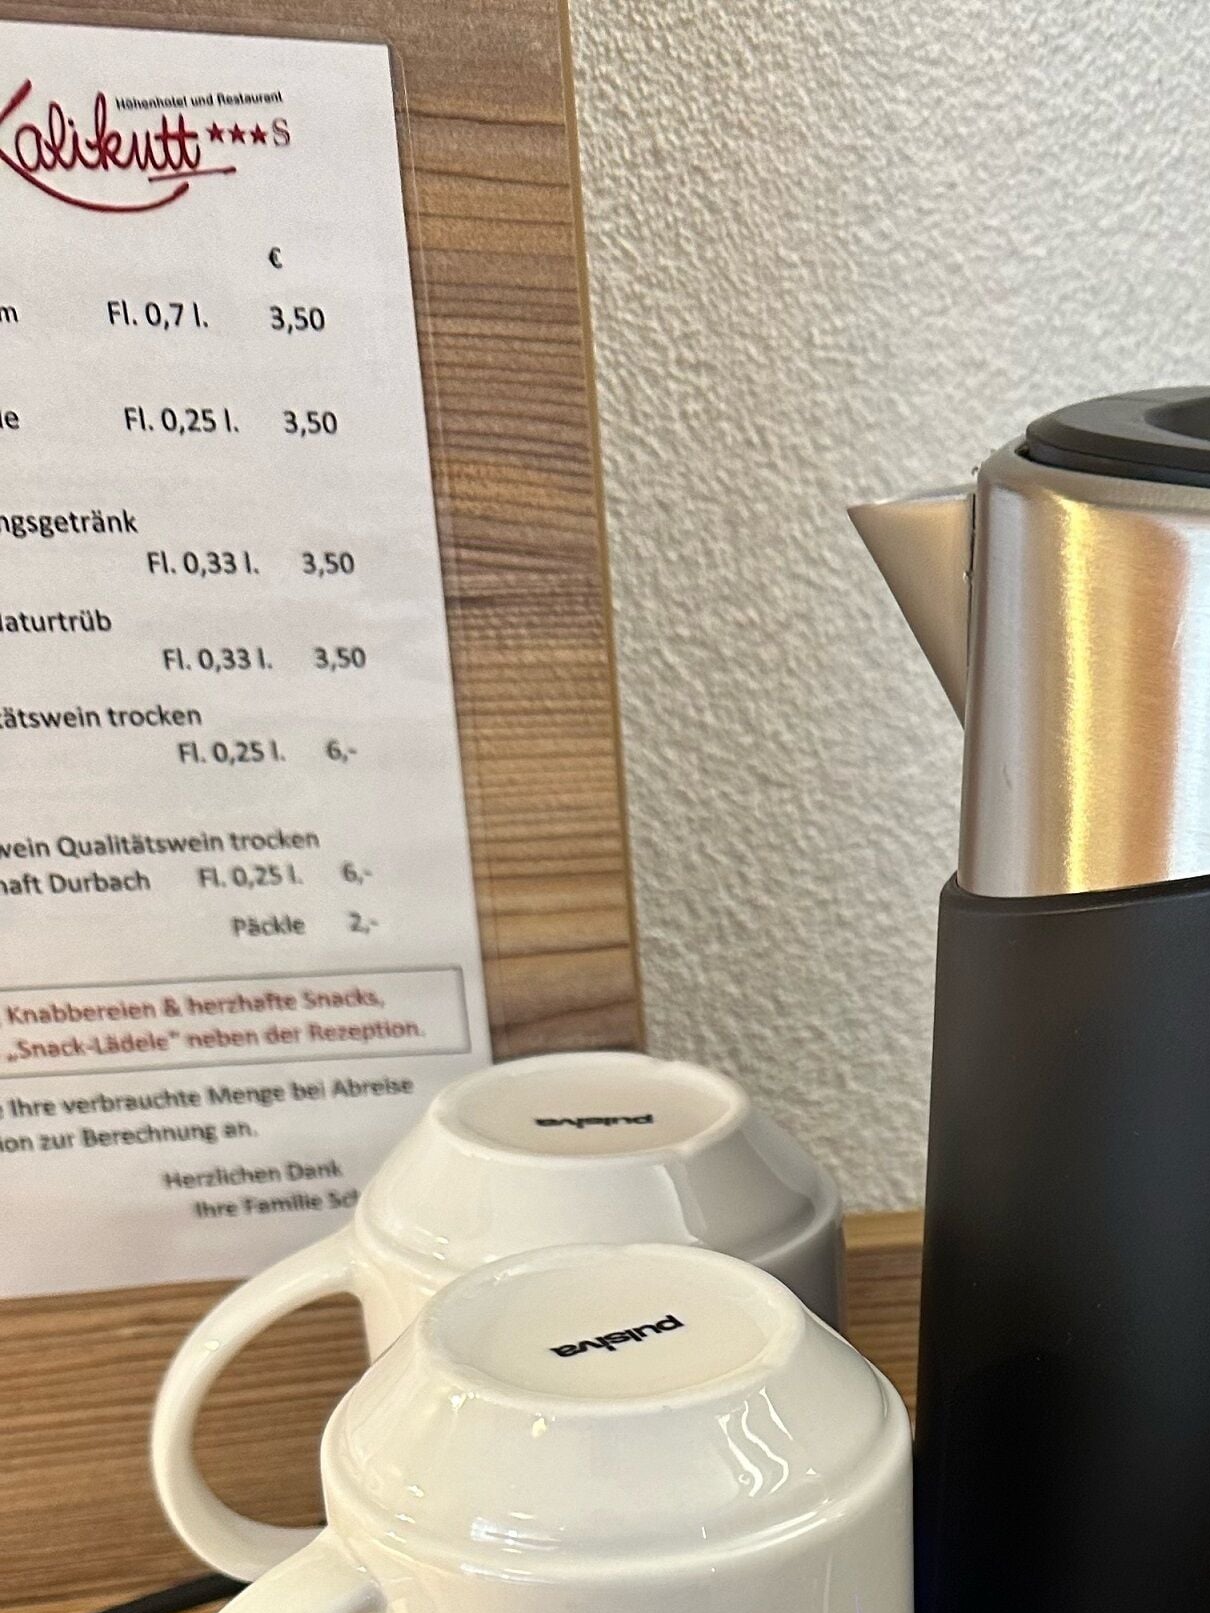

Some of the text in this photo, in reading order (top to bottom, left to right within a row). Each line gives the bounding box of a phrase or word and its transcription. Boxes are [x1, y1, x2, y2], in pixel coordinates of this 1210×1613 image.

[191, 95, 214, 107] und
[216, 90, 283, 107] Restaurant
[269, 248, 283, 269] €
[107, 301, 138, 327] Fl.
[145, 302, 183, 331] 0,7
[270, 306, 325, 335] 3,50
[124, 407, 154, 433] Fl.
[161, 408, 217, 436] 0,25
[283, 411, 337, 440] 3,50
[147, 551, 176, 575] Fl.
[183, 552, 237, 580] 0,33
[302, 552, 355, 578] 3,50
[163, 648, 191, 671] Fl.
[199, 649, 250, 674] 0,33
[314, 647, 366, 672] 3,50
[107, 705, 202, 728] trocken
[178, 742, 206, 766] Fl.
[213, 744, 264, 767] 0,25
[326, 739, 357, 764] 6,-
[57, 832, 223, 859] Qualitätswein
[230, 829, 320, 852] trocken
[49, 870, 150, 895] Durbach
[200, 866, 226, 889] Fl.
[233, 865, 282, 889] 0,25
[343, 861, 373, 886] 6,-
[232, 911, 378, 938] Päckle 2,-
[7, 1003, 157, 1025] Knabbereien
[163, 996, 182, 1018] &
[189, 991, 297, 1017] herzhafte
[187, 1029, 258, 1050] neben
[264, 1026, 302, 1045] der
[309, 1020, 424, 1046] Rezeption.
[62, 1090, 200, 1114] verbrauchte
[207, 1085, 284, 1110] Menge
[292, 1083, 326, 1101] bei
[331, 1076, 414, 1099] Abreise
[40, 1132, 75, 1151] zur
[82, 1124, 218, 1147] Berechnung
[164, 1159, 343, 1189] Herzlichen Dank
[244, 1190, 324, 1215] Familie
[549, 1313, 685, 1358] pulsiva
